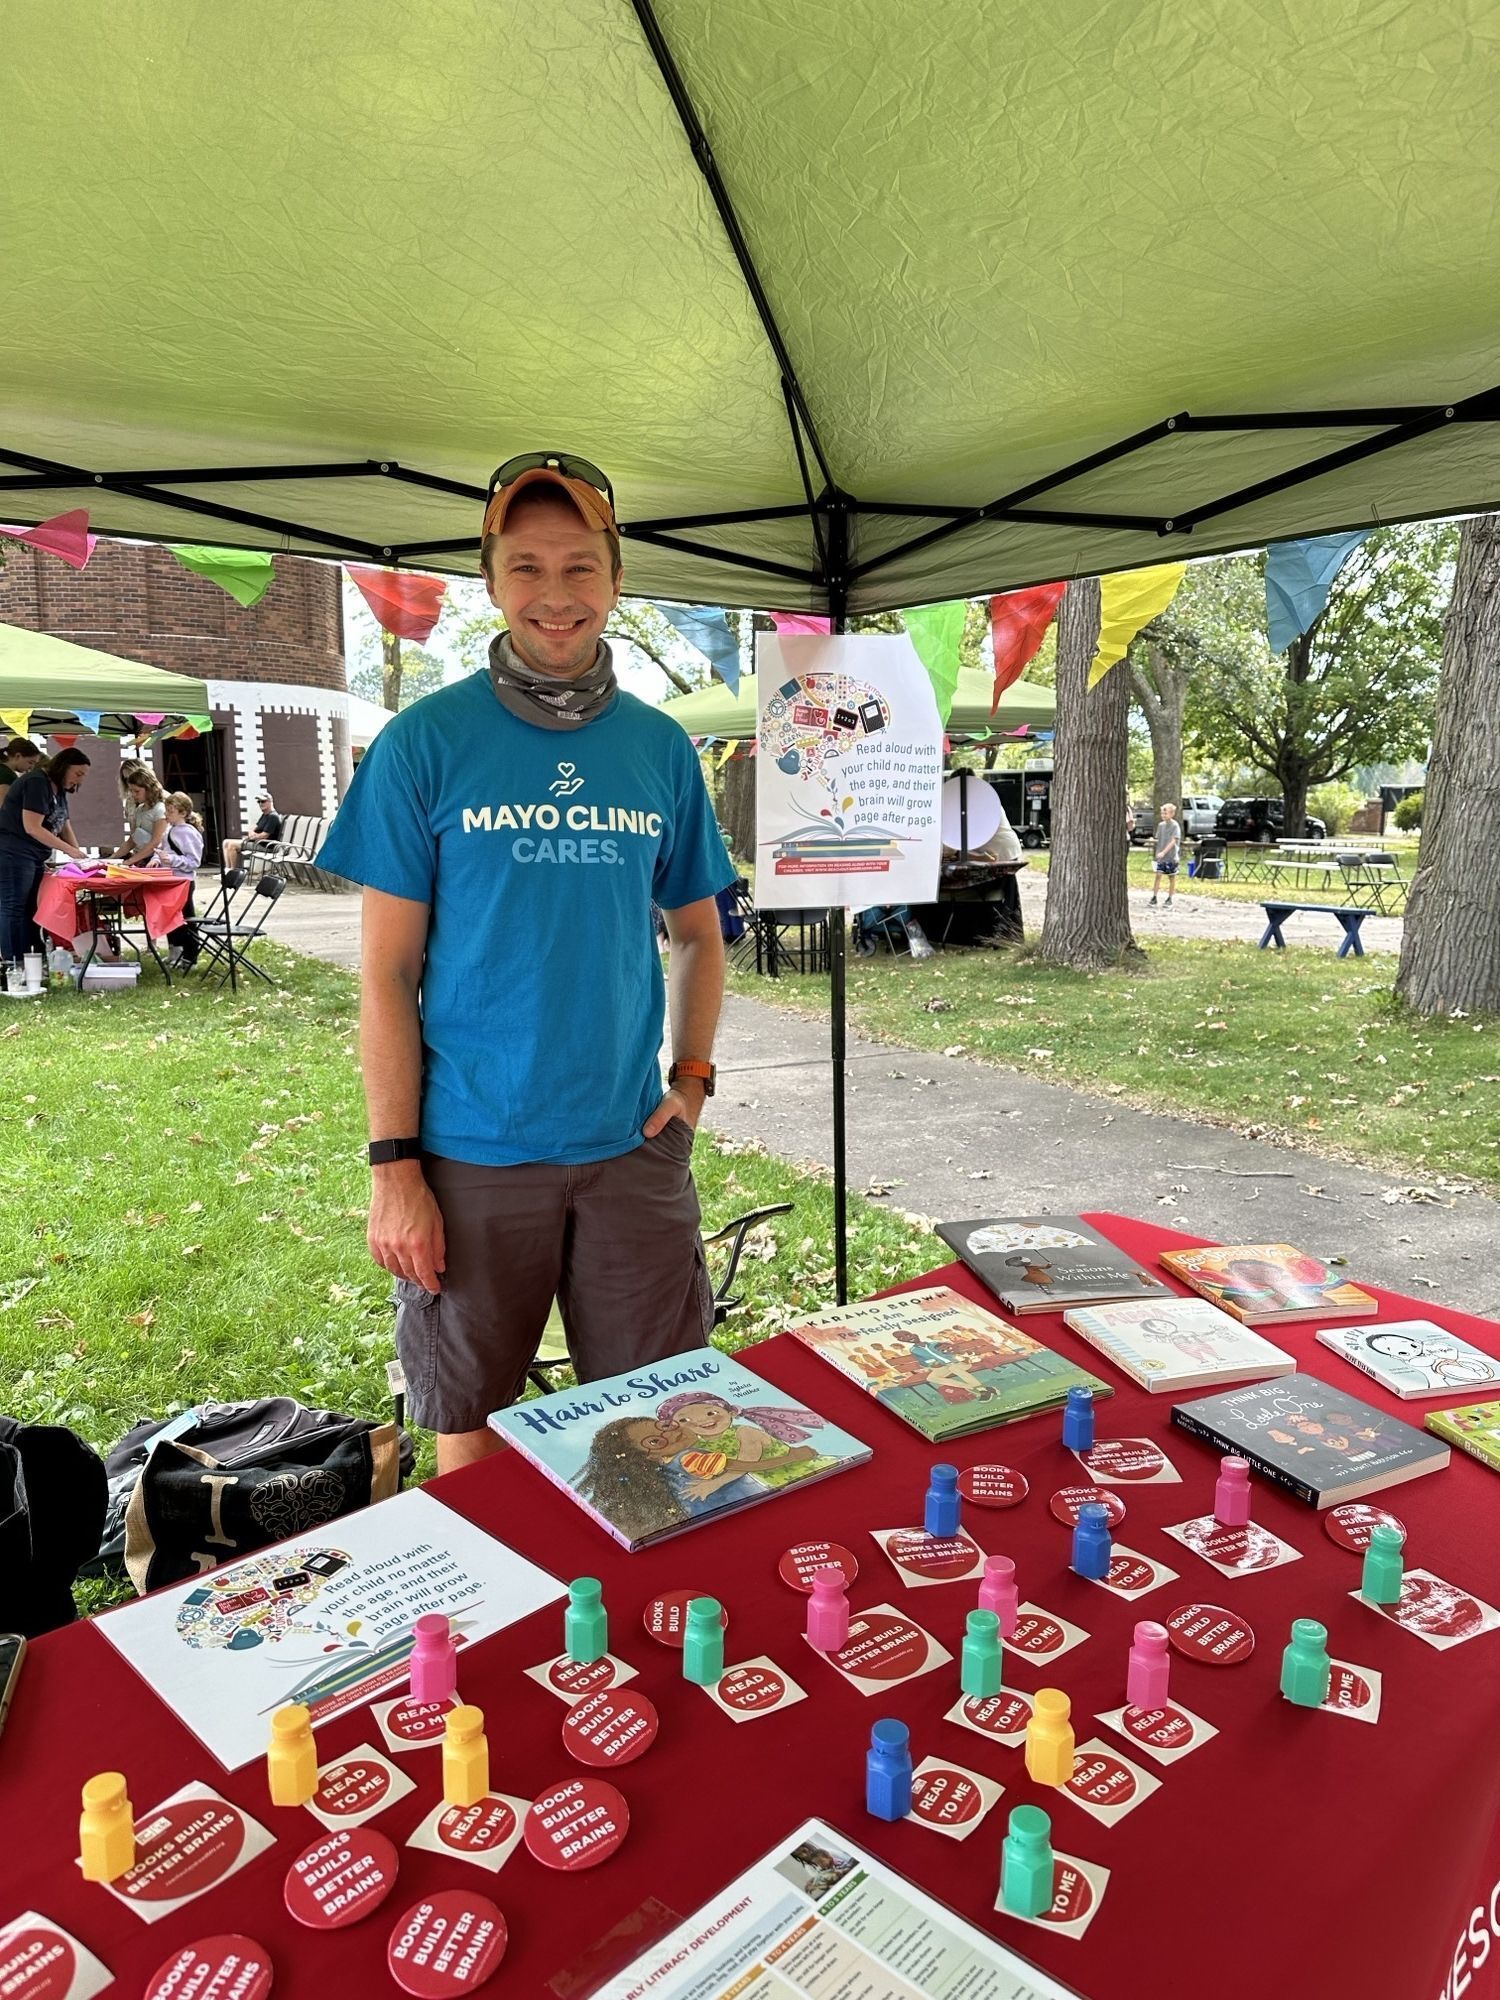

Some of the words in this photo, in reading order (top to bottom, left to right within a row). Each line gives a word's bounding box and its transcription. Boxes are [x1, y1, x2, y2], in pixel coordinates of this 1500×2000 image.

[856, 741, 882, 756] Read
[885, 741, 913, 755] aloud
[914, 744, 936, 756] with
[841, 763, 864, 779] your
[867, 759, 891, 771] child
[893, 763, 906, 772] no
[908, 764, 940, 774] matter
[849, 779, 866, 791] the
[868, 779, 890, 790] age,
[892, 779, 911, 790] and
[913, 779, 936, 791] their
[858, 794, 885, 807] brain
[887, 796, 905, 807] will
[906, 799, 932, 810] grow
[462, 804, 560, 833] MAYO
[566, 805, 662, 838] CLINIC
[854, 812, 879, 825] page
[882, 811, 905, 824] after
[907, 815, 936, 827] page.
[511, 837, 626, 866] CARES.
[1057, 1265, 1114, 1275] Seasons
[1175, 1249, 1212, 1272] Your
[1055, 1271, 1104, 1282] Within
[1107, 1271, 1131, 1280] Me
[806, 1307, 880, 1328] KARAMO
[889, 1290, 947, 1311] BROWN
[882, 1312, 905, 1321] Am
[838, 1321, 900, 1340] Perfectly
[902, 1307, 961, 1326] Designed
[514, 1400, 605, 1434] Hair
[601, 1391, 632, 1407] to
[626, 1360, 720, 1399] Share
[728, 1380, 738, 1388] by
[732, 1386, 761, 1399] Walker
[1220, 1391, 1260, 1407] THINK
[1259, 1387, 1290, 1397] BIG,
[1229, 1407, 1284, 1430] Little
[1272, 1395, 1325, 1414] One
[1087, 1458, 1124, 1466] BETTER
[1121, 1449, 1150, 1457] BUILD
[1212, 1436, 1230, 1450] THINK
[1243, 1455, 1262, 1470] LITTLE
[1262, 1467, 1277, 1478] ONE
[1464, 1440, 1489, 1463] Baby
[972, 1466, 1011, 1474] BOOKS
[972, 1481, 1014, 1489] BETTER
[972, 1488, 1013, 1497] BRAINS
[1060, 1487, 1098, 1496] BOOKS
[1064, 1495, 1097, 1504] BUILD
[790, 1543, 831, 1556] BOOKS
[793, 1552, 828, 1564] BUILD
[895, 1542, 932, 1554] BOOKS
[896, 1551, 935, 1563] BETTER
[936, 1547, 975, 1558] BRAINS
[1205, 1544, 1238, 1557] BETTER
[324, 1572, 361, 1595] Read
[363, 1554, 402, 1576] aloud
[402, 1542, 433, 1560] with
[797, 1561, 842, 1574] BETTER
[1116, 1575, 1134, 1587] TO
[1132, 1565, 1149, 1578] ME
[319, 1593, 350, 1616] your
[352, 1576, 387, 1597] child
[387, 1569, 406, 1582] no
[408, 1550, 452, 1572] matter
[342, 1603, 367, 1619] the
[367, 1588, 399, 1606] age,
[401, 1574, 426, 1591] and
[427, 1560, 459, 1579] their
[364, 1599, 405, 1622] brain
[405, 1586, 432, 1603] will
[433, 1572, 469, 1594] grow
[373, 1612, 410, 1636] page
[412, 1598, 445, 1616] after
[448, 1580, 487, 1604] page.
[217, 1614, 243, 1635] LEARN
[652, 1601, 664, 1632] BOOKS
[669, 1606, 680, 1632] BUILD
[1010, 1618, 1039, 1642] READ
[1169, 1605, 1202, 1630] BOOKS
[1182, 1616, 1211, 1638] BUILD
[837, 1639, 875, 1660] BOOKS
[873, 1625, 904, 1643] BUILD
[1024, 1635, 1045, 1650] TO
[1038, 1625, 1058, 1641] ME
[1196, 1620, 1233, 1647] BETTER
[1211, 1629, 1246, 1657] BRAINS
[841, 1648, 883, 1670] BETTER
[880, 1630, 919, 1651] BRAINS
[569, 1677, 592, 1691] TO
[592, 1664, 611, 1679] ME
[725, 1674, 765, 1695] READ
[1340, 1672, 1354, 1689] ME
[735, 1692, 758, 1706] TO
[759, 1682, 781, 1697] ME
[1338, 1688, 1353, 1709] TO
[397, 1702, 441, 1722] READ
[566, 1691, 609, 1727] BOOKS
[578, 1705, 614, 1736] BUILD
[975, 1695, 1002, 1722] READ
[993, 1712, 1010, 1730] TO
[1005, 1699, 1024, 1717] ME
[1131, 1710, 1165, 1732] READ
[401, 1721, 427, 1735] TO
[590, 1707, 637, 1746] BETTER
[603, 1718, 648, 1757] BRAINS
[1148, 1729, 1169, 1743] TO
[1165, 1718, 1187, 1736] ME
[322, 1768, 367, 1799] READ
[1070, 1760, 1107, 1787] READ
[1087, 1783, 1110, 1799] TO
[1106, 1770, 1129, 1789] ME
[333, 1792, 358, 1809] TO
[361, 1775, 385, 1795] ME
[532, 1781, 584, 1816] BOOKS
[919, 1777, 948, 1811] READ
[938, 1800, 957, 1820] TO
[953, 1781, 972, 1802] ME
[450, 1805, 483, 1840] READ
[469, 1829, 492, 1846] TO
[490, 1807, 507, 1828] ME
[541, 1799, 586, 1829] BUILD
[550, 1806, 608, 1844] BETTER
[124, 1842, 175, 1881] BOOKS
[174, 1811, 216, 1844] BUILD
[294, 1832, 351, 1873] BOOKS
[560, 1821, 616, 1859] BRAINS
[127, 1853, 184, 1894] BETTER
[183, 1814, 235, 1855] BRAINS
[303, 1850, 351, 1887] BUILD
[313, 1855, 375, 1901] BETTER
[322, 1869, 384, 1916] BRAINS
[839, 1880, 857, 1897] YEARS
[1051, 1892, 1069, 1915] TO
[1063, 1870, 1077, 1894] ME
[393, 1904, 434, 1959] BOOKS
[412, 1918, 447, 1966] BUILD
[432, 1912, 475, 1973] BETTER
[646, 1947, 691, 1986] LITERACY
[689, 1896, 753, 1950] DEVELOPMENT
[786, 1927, 807, 1945] YEARS
[453, 1920, 494, 1980] BRAINS
[1, 1944, 65, 1995] BRAINS
